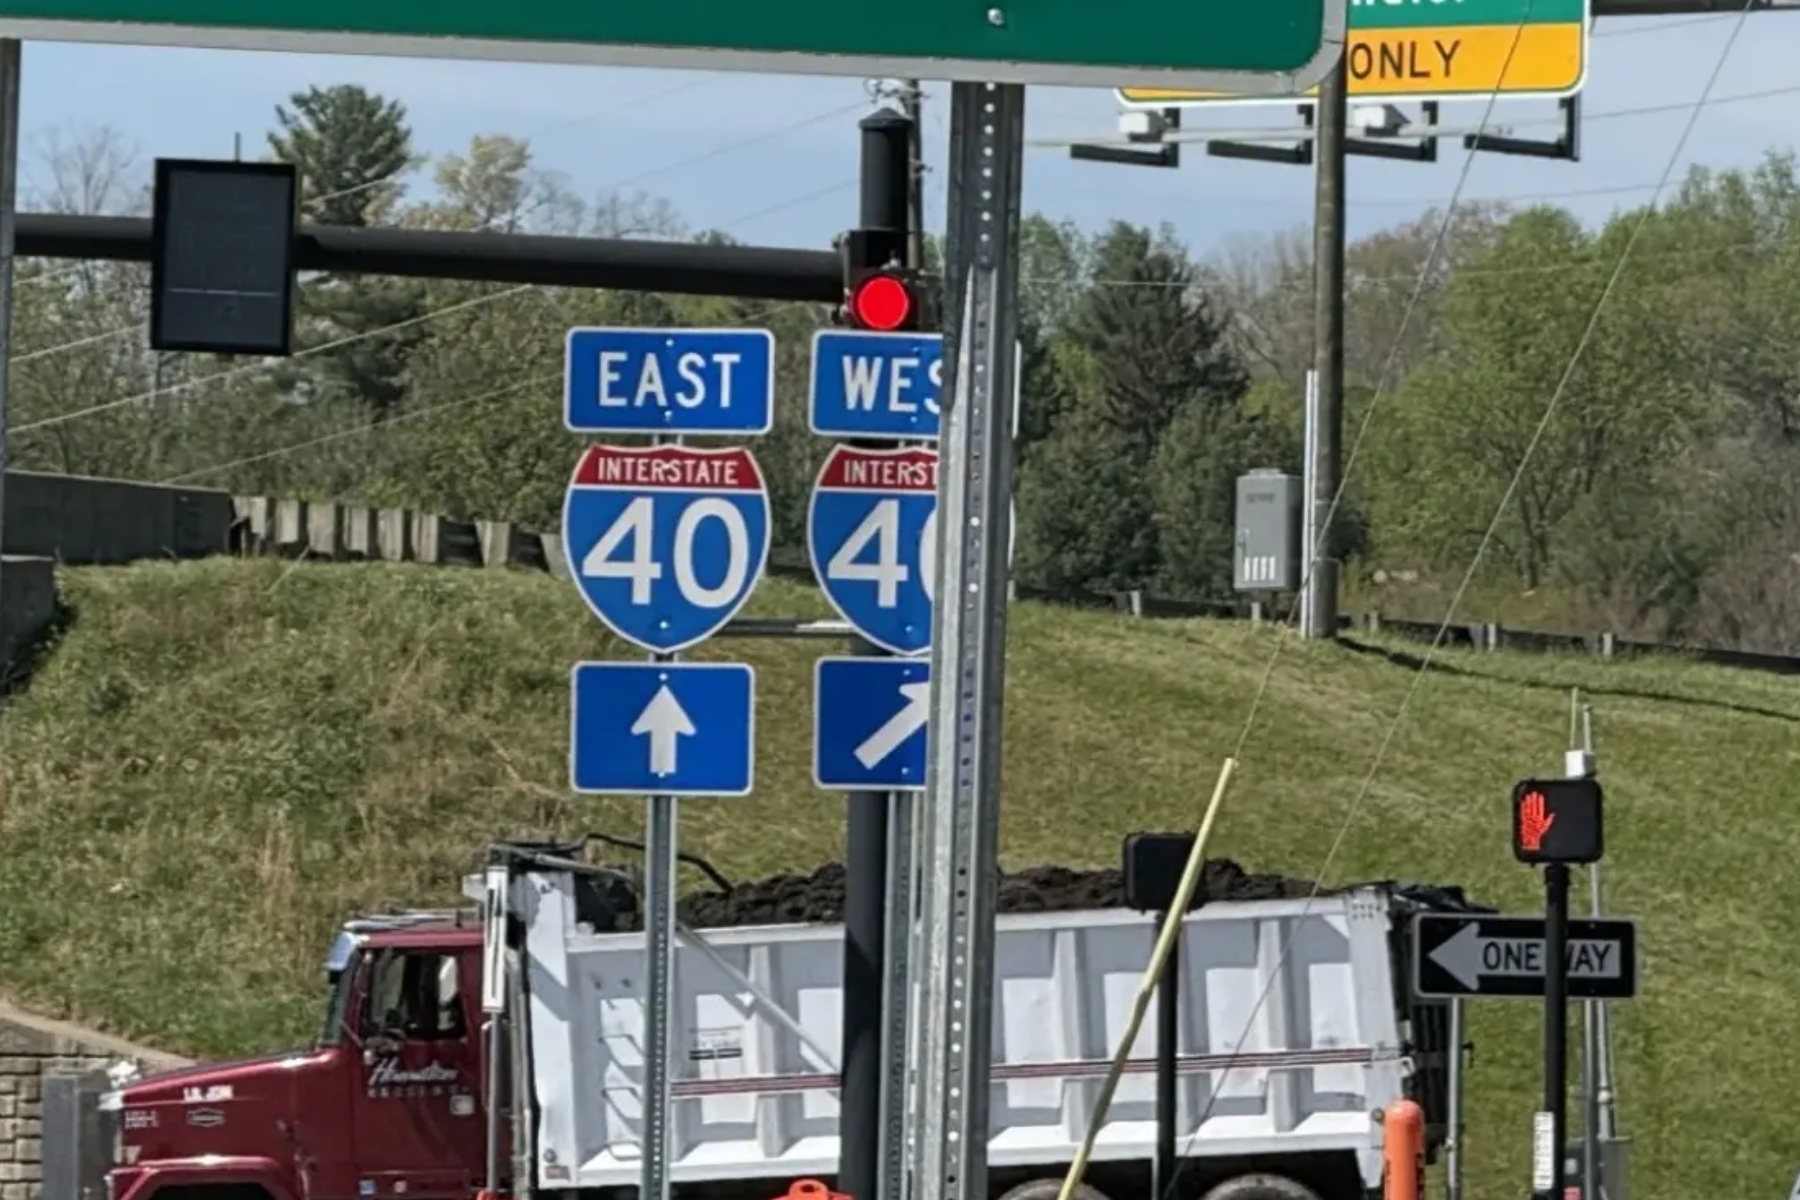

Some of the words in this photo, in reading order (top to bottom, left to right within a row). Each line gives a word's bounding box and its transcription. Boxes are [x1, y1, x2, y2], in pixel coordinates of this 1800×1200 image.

[1350, 40, 1461, 79] ONLY
[599, 351, 741, 408] EAST
[842, 355, 942, 415] WES
[598, 457, 739, 485] INTERSTATE
[844, 459, 939, 485] INTERST
[582, 497, 748, 608] 40
[828, 499, 936, 608] 4
[1482, 941, 1541, 971] ONE
[1565, 943, 1612, 972] AY
